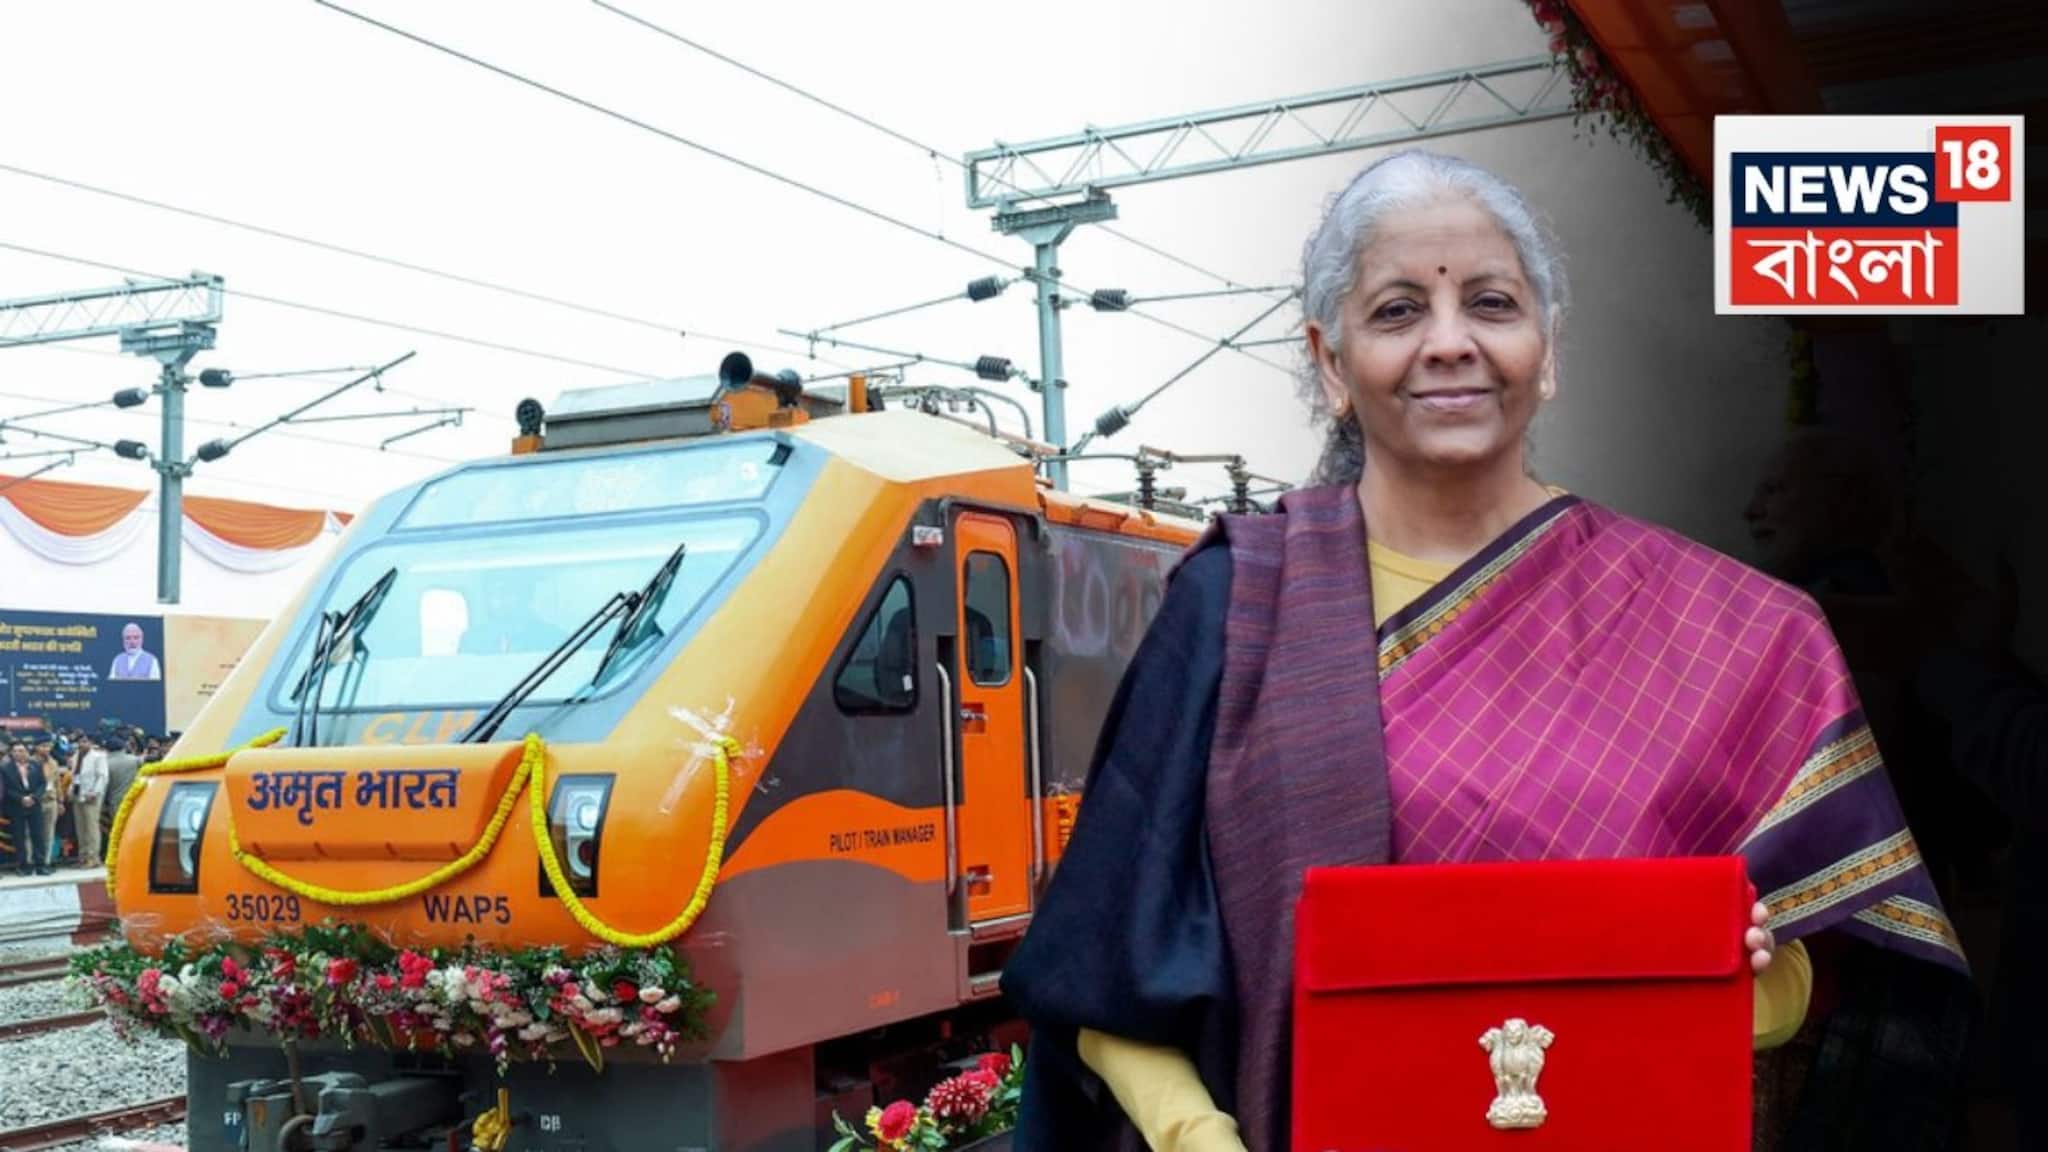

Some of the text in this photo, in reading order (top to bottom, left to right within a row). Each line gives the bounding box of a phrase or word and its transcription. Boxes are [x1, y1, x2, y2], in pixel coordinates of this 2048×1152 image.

[247, 768, 461, 826] अमृत भारत
[829, 831, 857, 852] PILOT
[864, 829, 890, 848] TRAIN
[893, 823, 935, 845] MANAGER
[225, 893, 301, 923] 35029
[424, 895, 512, 925] WAP5
